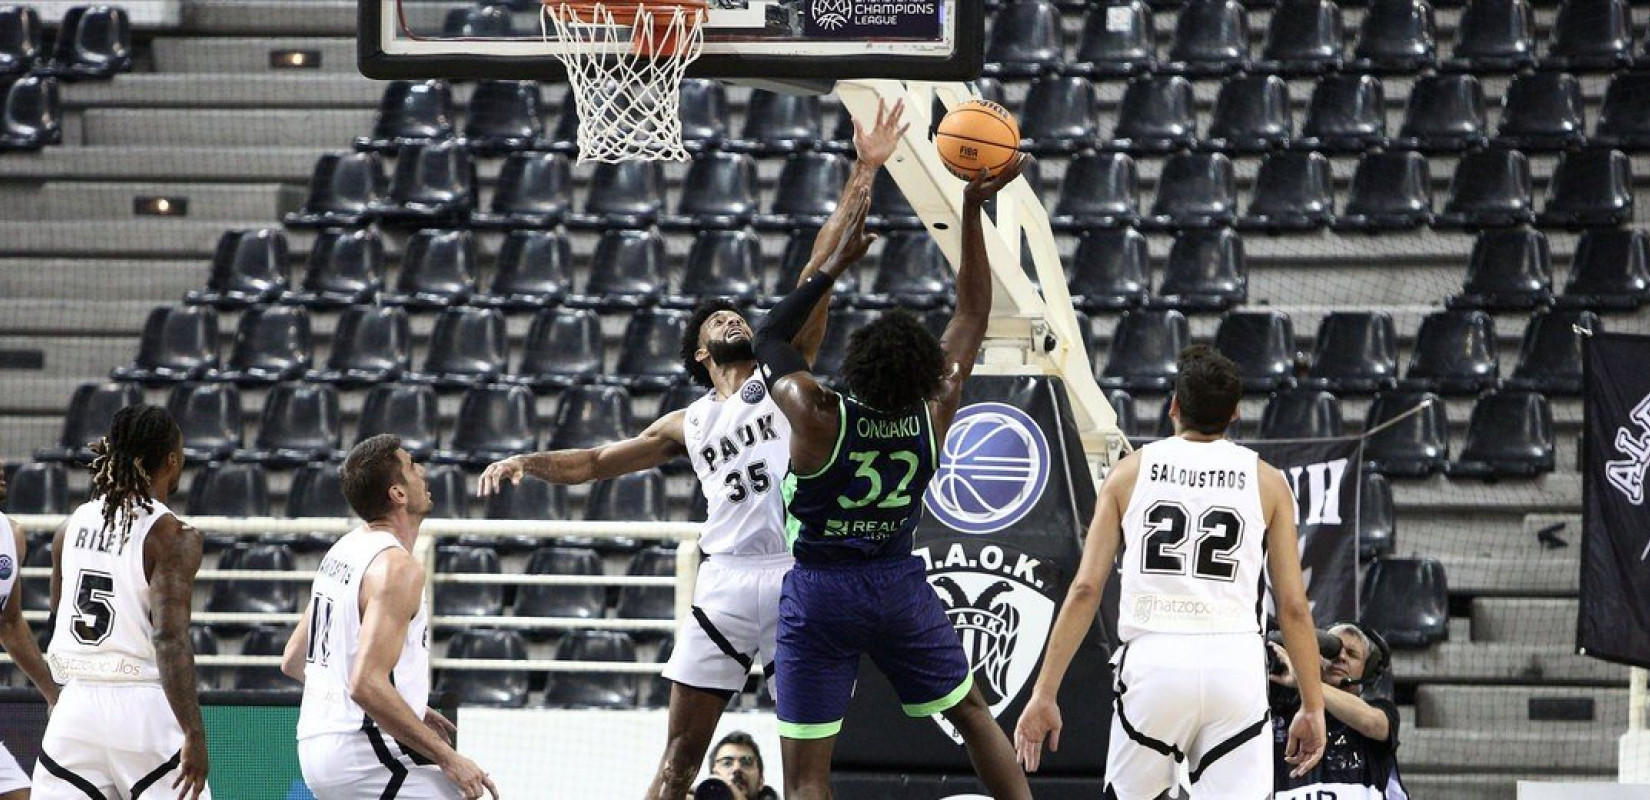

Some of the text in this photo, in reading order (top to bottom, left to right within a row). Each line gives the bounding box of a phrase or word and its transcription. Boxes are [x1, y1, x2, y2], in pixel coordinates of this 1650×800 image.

[855, 4, 934, 15] CHAMPIONS
[855, 15, 898, 25] LEAGUE
[959, 145, 978, 157] FIBA
[701, 411, 780, 474] PAOK
[724, 459, 770, 504] 35
[836, 450, 919, 510] 32
[1150, 463, 1247, 491] SALOUSTROS
[74, 527, 131, 557] RILEY
[1140, 500, 1246, 583] 22
[70, 568, 116, 647] 5
